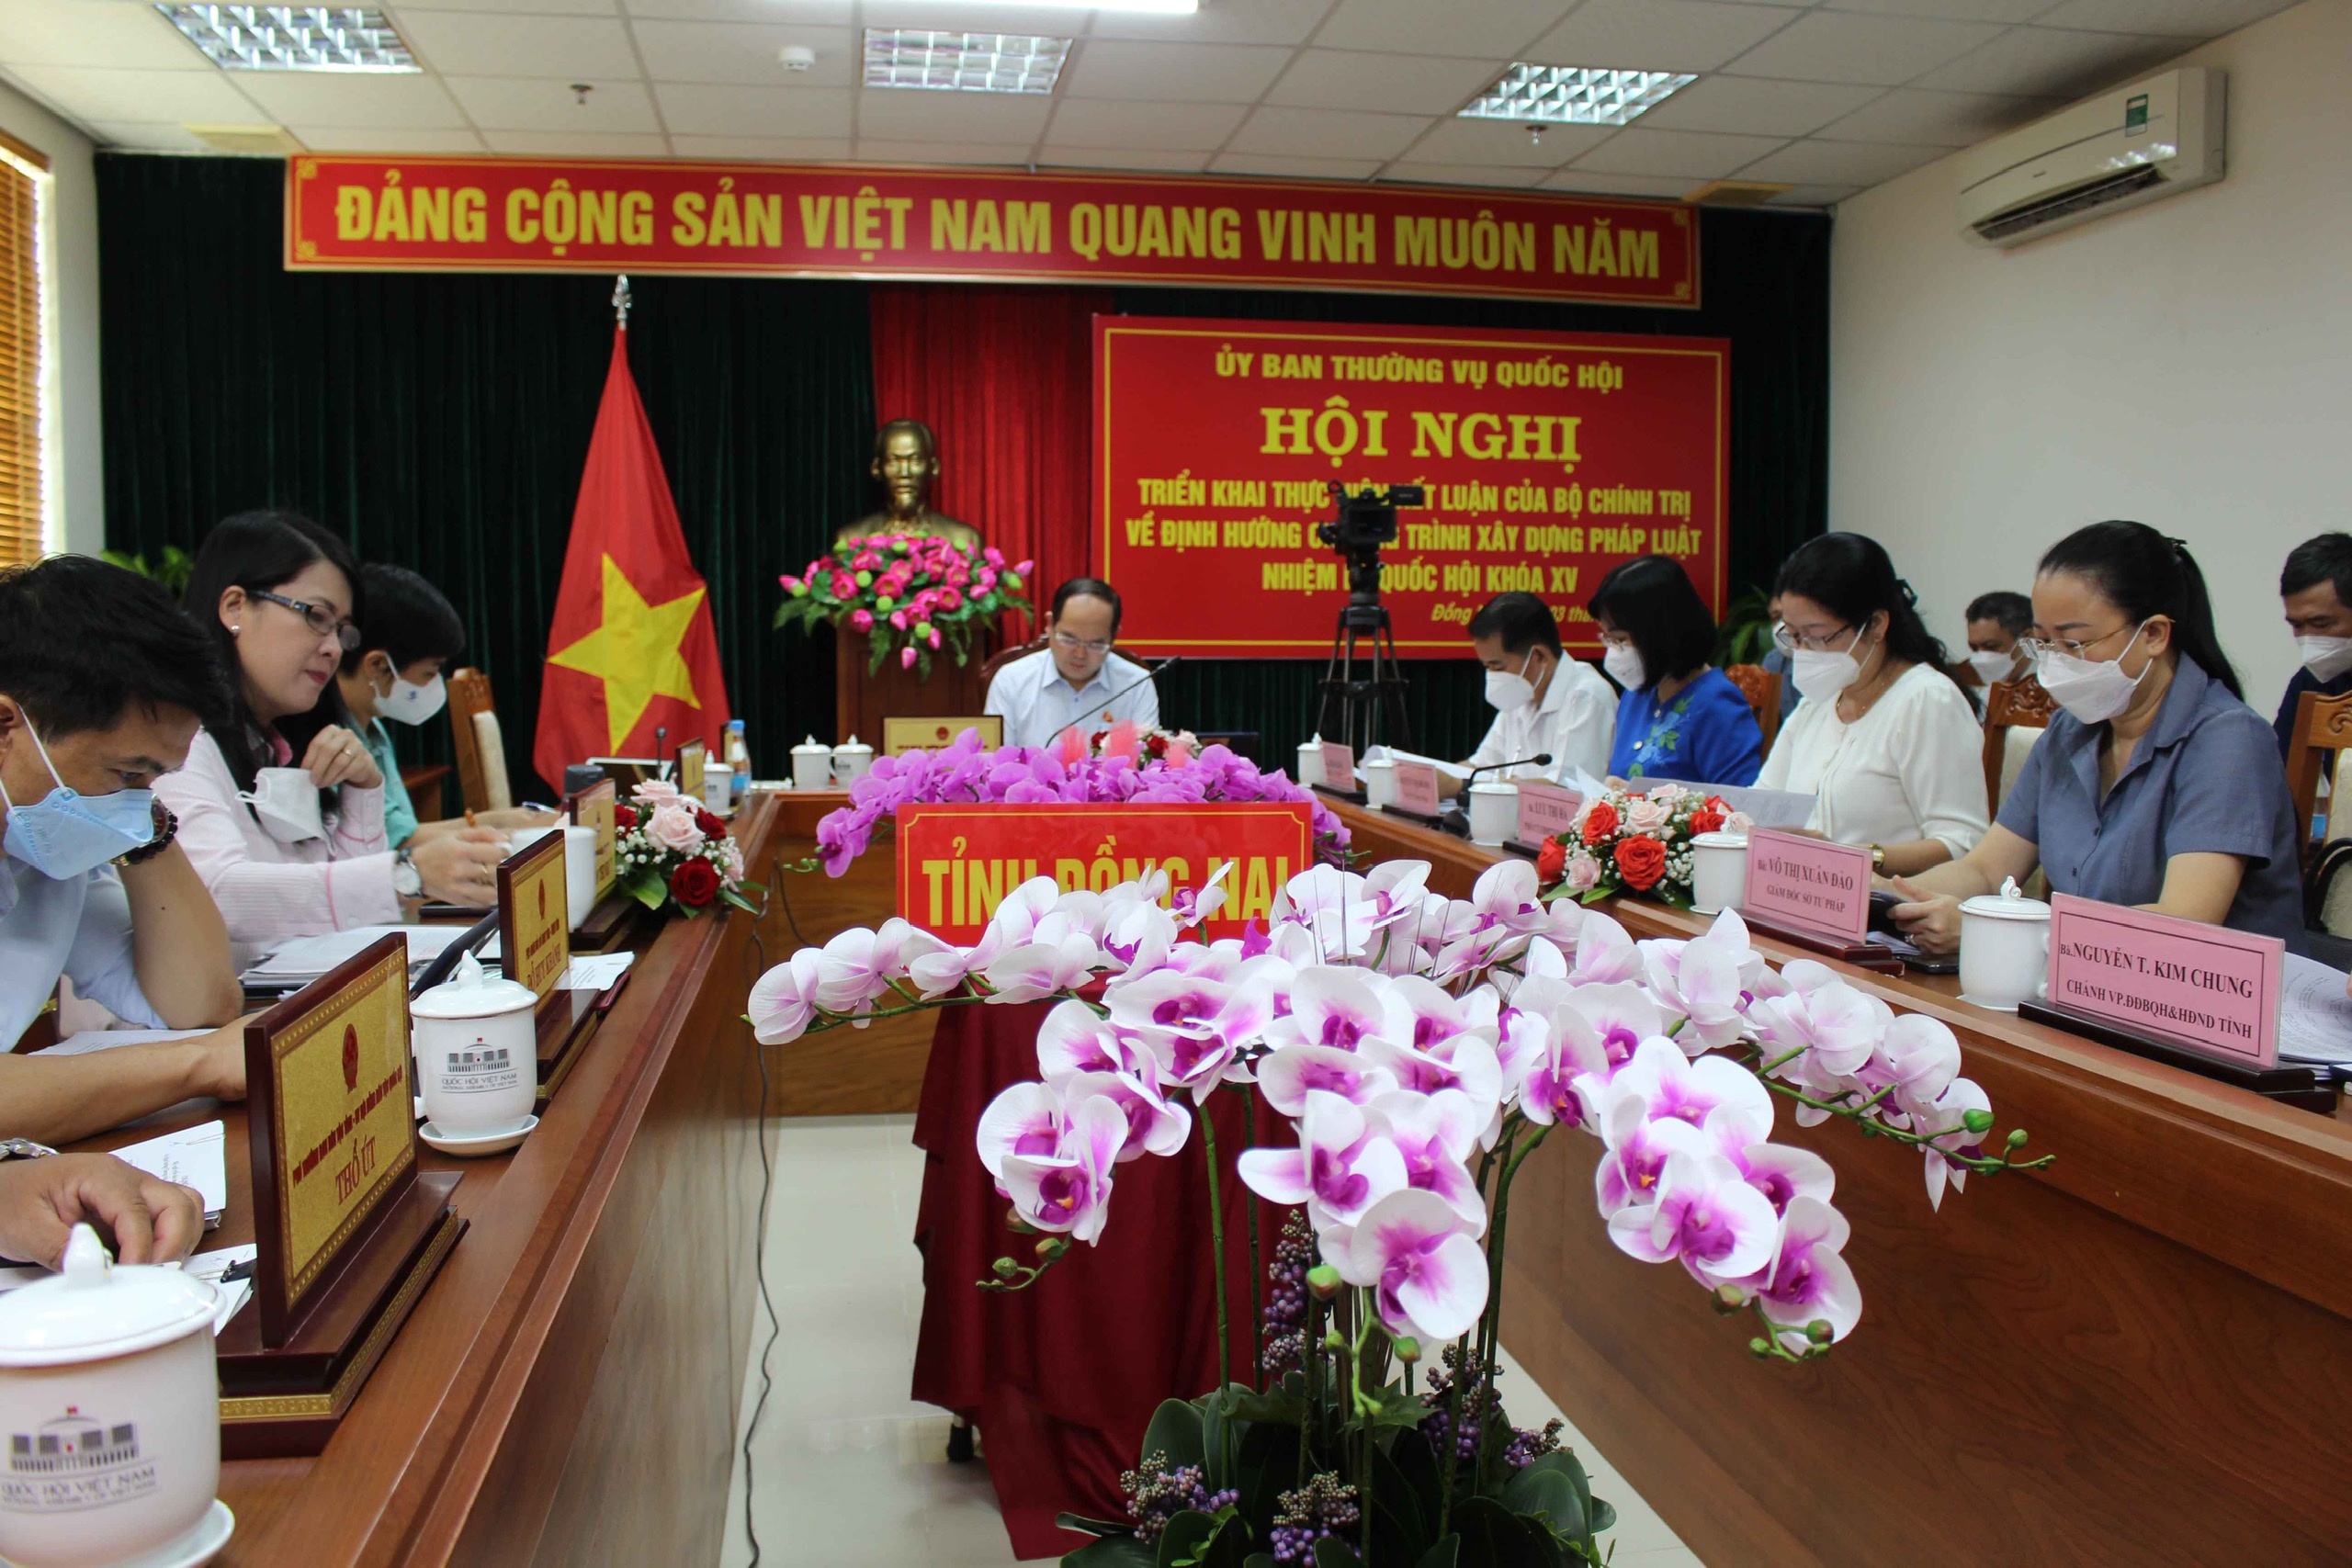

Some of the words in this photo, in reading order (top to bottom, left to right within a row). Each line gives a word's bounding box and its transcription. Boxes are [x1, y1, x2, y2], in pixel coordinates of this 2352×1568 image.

[334, 169, 487, 243] ĐẢNG
[505, 178, 654, 256] CỘNG
[672, 176, 783, 248] SẢN
[798, 186, 914, 261] VIỆT
[931, 197, 1052, 254] NAM
[1069, 202, 1241, 262] QUANG
[1257, 209, 1376, 265] VINH
[1394, 209, 1536, 272] MUÔN
[1553, 218, 1659, 279] NĂM
[1216, 344, 1254, 378] ỦY
[1261, 353, 1323, 379] BAN
[1329, 352, 1444, 383] THƯỜNG
[1451, 359, 1488, 389] VỤ
[1495, 355, 1570, 389] QUỐC
[1577, 360, 1623, 394] HỘI
[1260, 395, 1388, 468] HỘI
[1410, 411, 1582, 474] NGHỊ
[1137, 468, 1206, 507] TRIỂN
[1211, 479, 1267, 508] KHAI
[1271, 479, 1331, 514] THỰC
[1441, 479, 1499, 517] LUẬN
[1503, 478, 1549, 513] CỦA
[1553, 482, 1583, 519] BỘ
[1588, 484, 1654, 515] CHÍNH
[1657, 490, 1691, 523] TRỊ
[1125, 510, 1156, 547] VỀ
[1159, 519, 1218, 553] ĐỊNH
[1223, 514, 1303, 549] HƯỚNG
[1405, 518, 1471, 551] TRÌNH
[1476, 520, 1520, 552] XÂY
[1524, 524, 1584, 558] DỰNG
[1589, 523, 1647, 554] PHÁP
[1651, 524, 1702, 560] LUẬT
[1261, 558, 1338, 596] NHIỆM
[1378, 555, 1438, 594] QUỐC
[1442, 559, 1481, 598] HỘI
[1486, 560, 1545, 594] KHÓA
[1549, 566, 1579, 593] XV
[1430, 602, 1473, 626] Đồng
[1783, 862, 1801, 882] THỊ
[1802, 864, 1829, 885] XUÂN
[1831, 870, 1854, 891] ĐÀO
[1825, 898, 1846, 913] PHÁP
[2137, 956, 2151, 975] T.
[2154, 960, 2187, 983] KIM
[2190, 968, 2254, 999] CHUNG
[2066, 977, 2106, 1001] CHÁNH
[2218, 1015, 2253, 1039] TỈNH
[501, 1072, 517, 1081] NAM
[360, 1134, 377, 1178] ÚT
